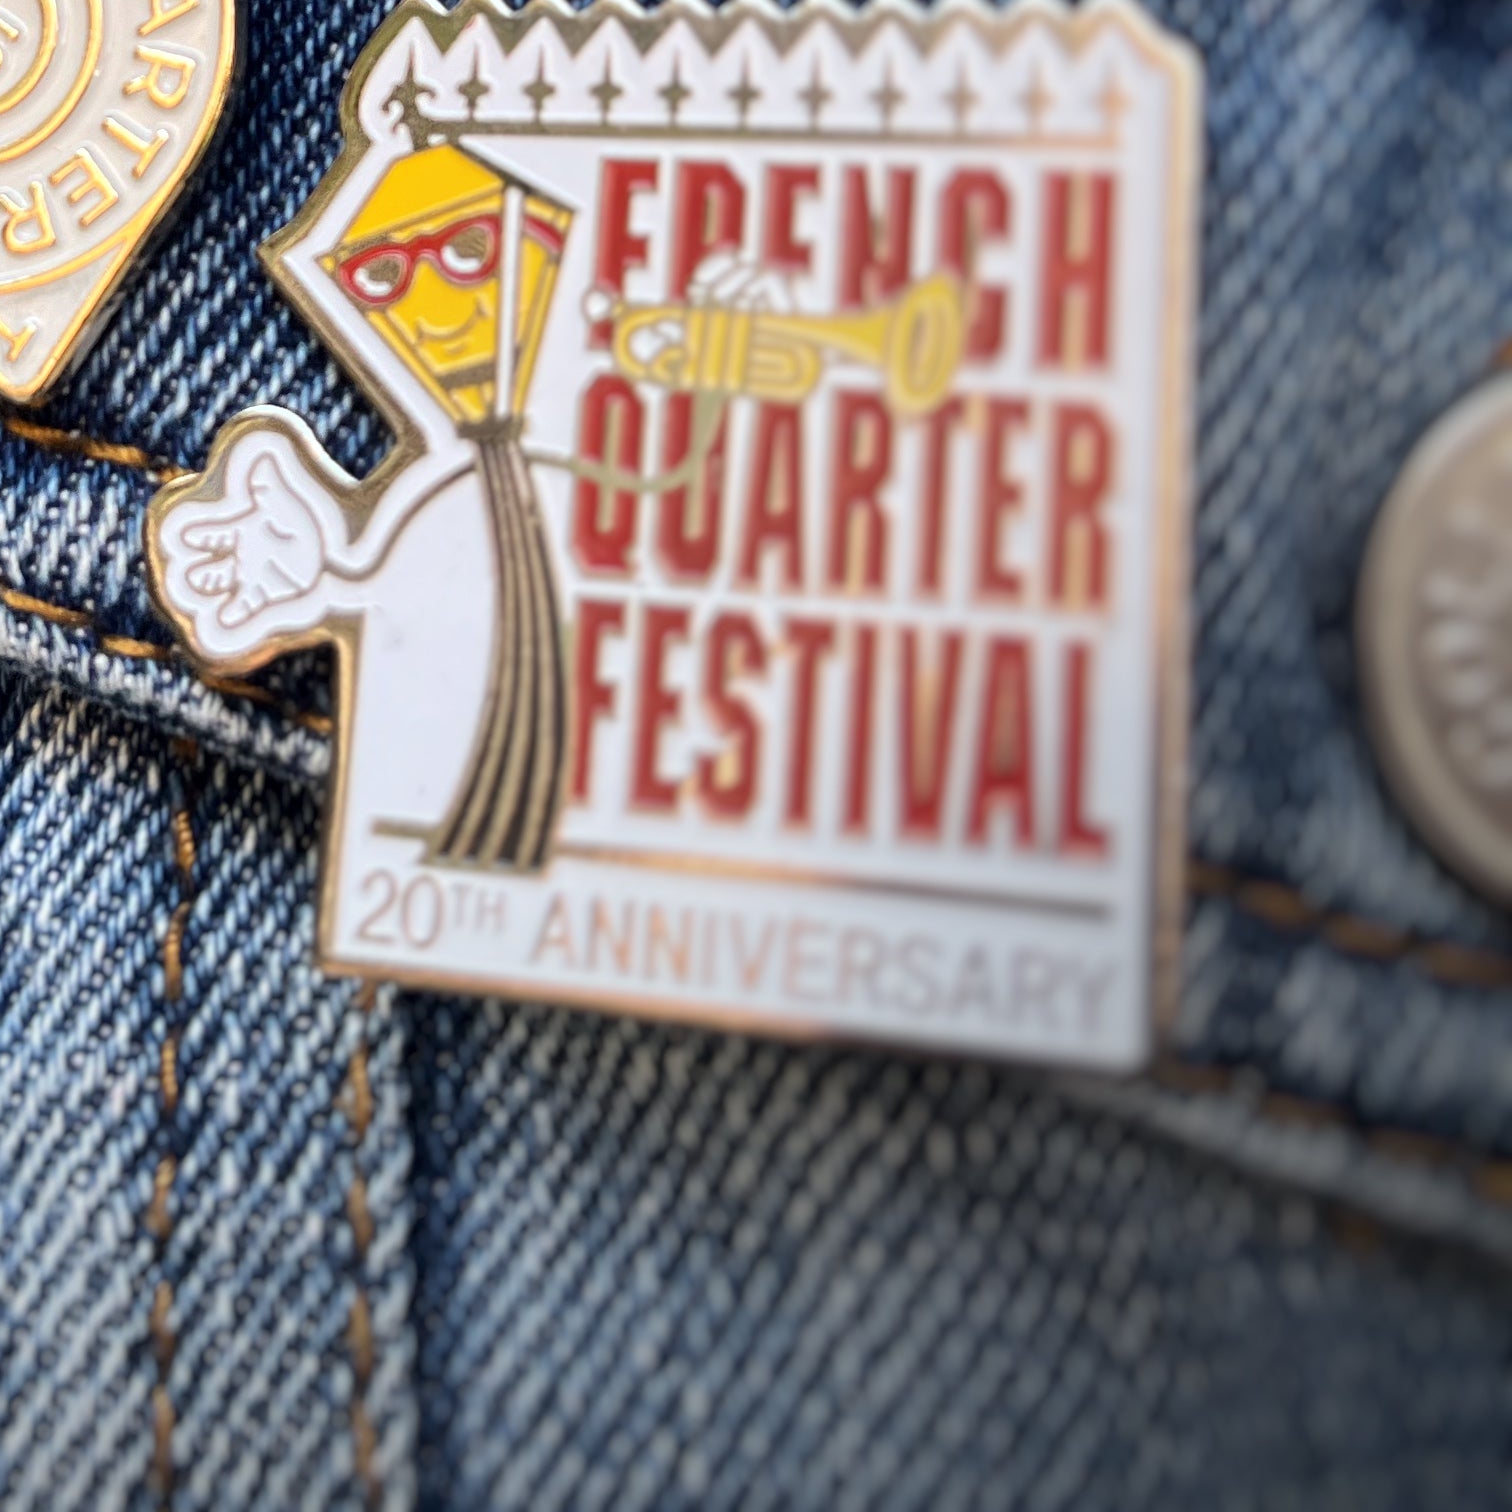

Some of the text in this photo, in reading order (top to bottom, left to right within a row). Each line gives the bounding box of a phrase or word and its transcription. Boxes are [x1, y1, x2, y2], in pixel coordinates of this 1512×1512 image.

[570, 371, 1118, 614] QUARTER
[570, 596, 1110, 860] FESTIVAL
[528, 890, 1121, 1031] ANNIVERSARY
